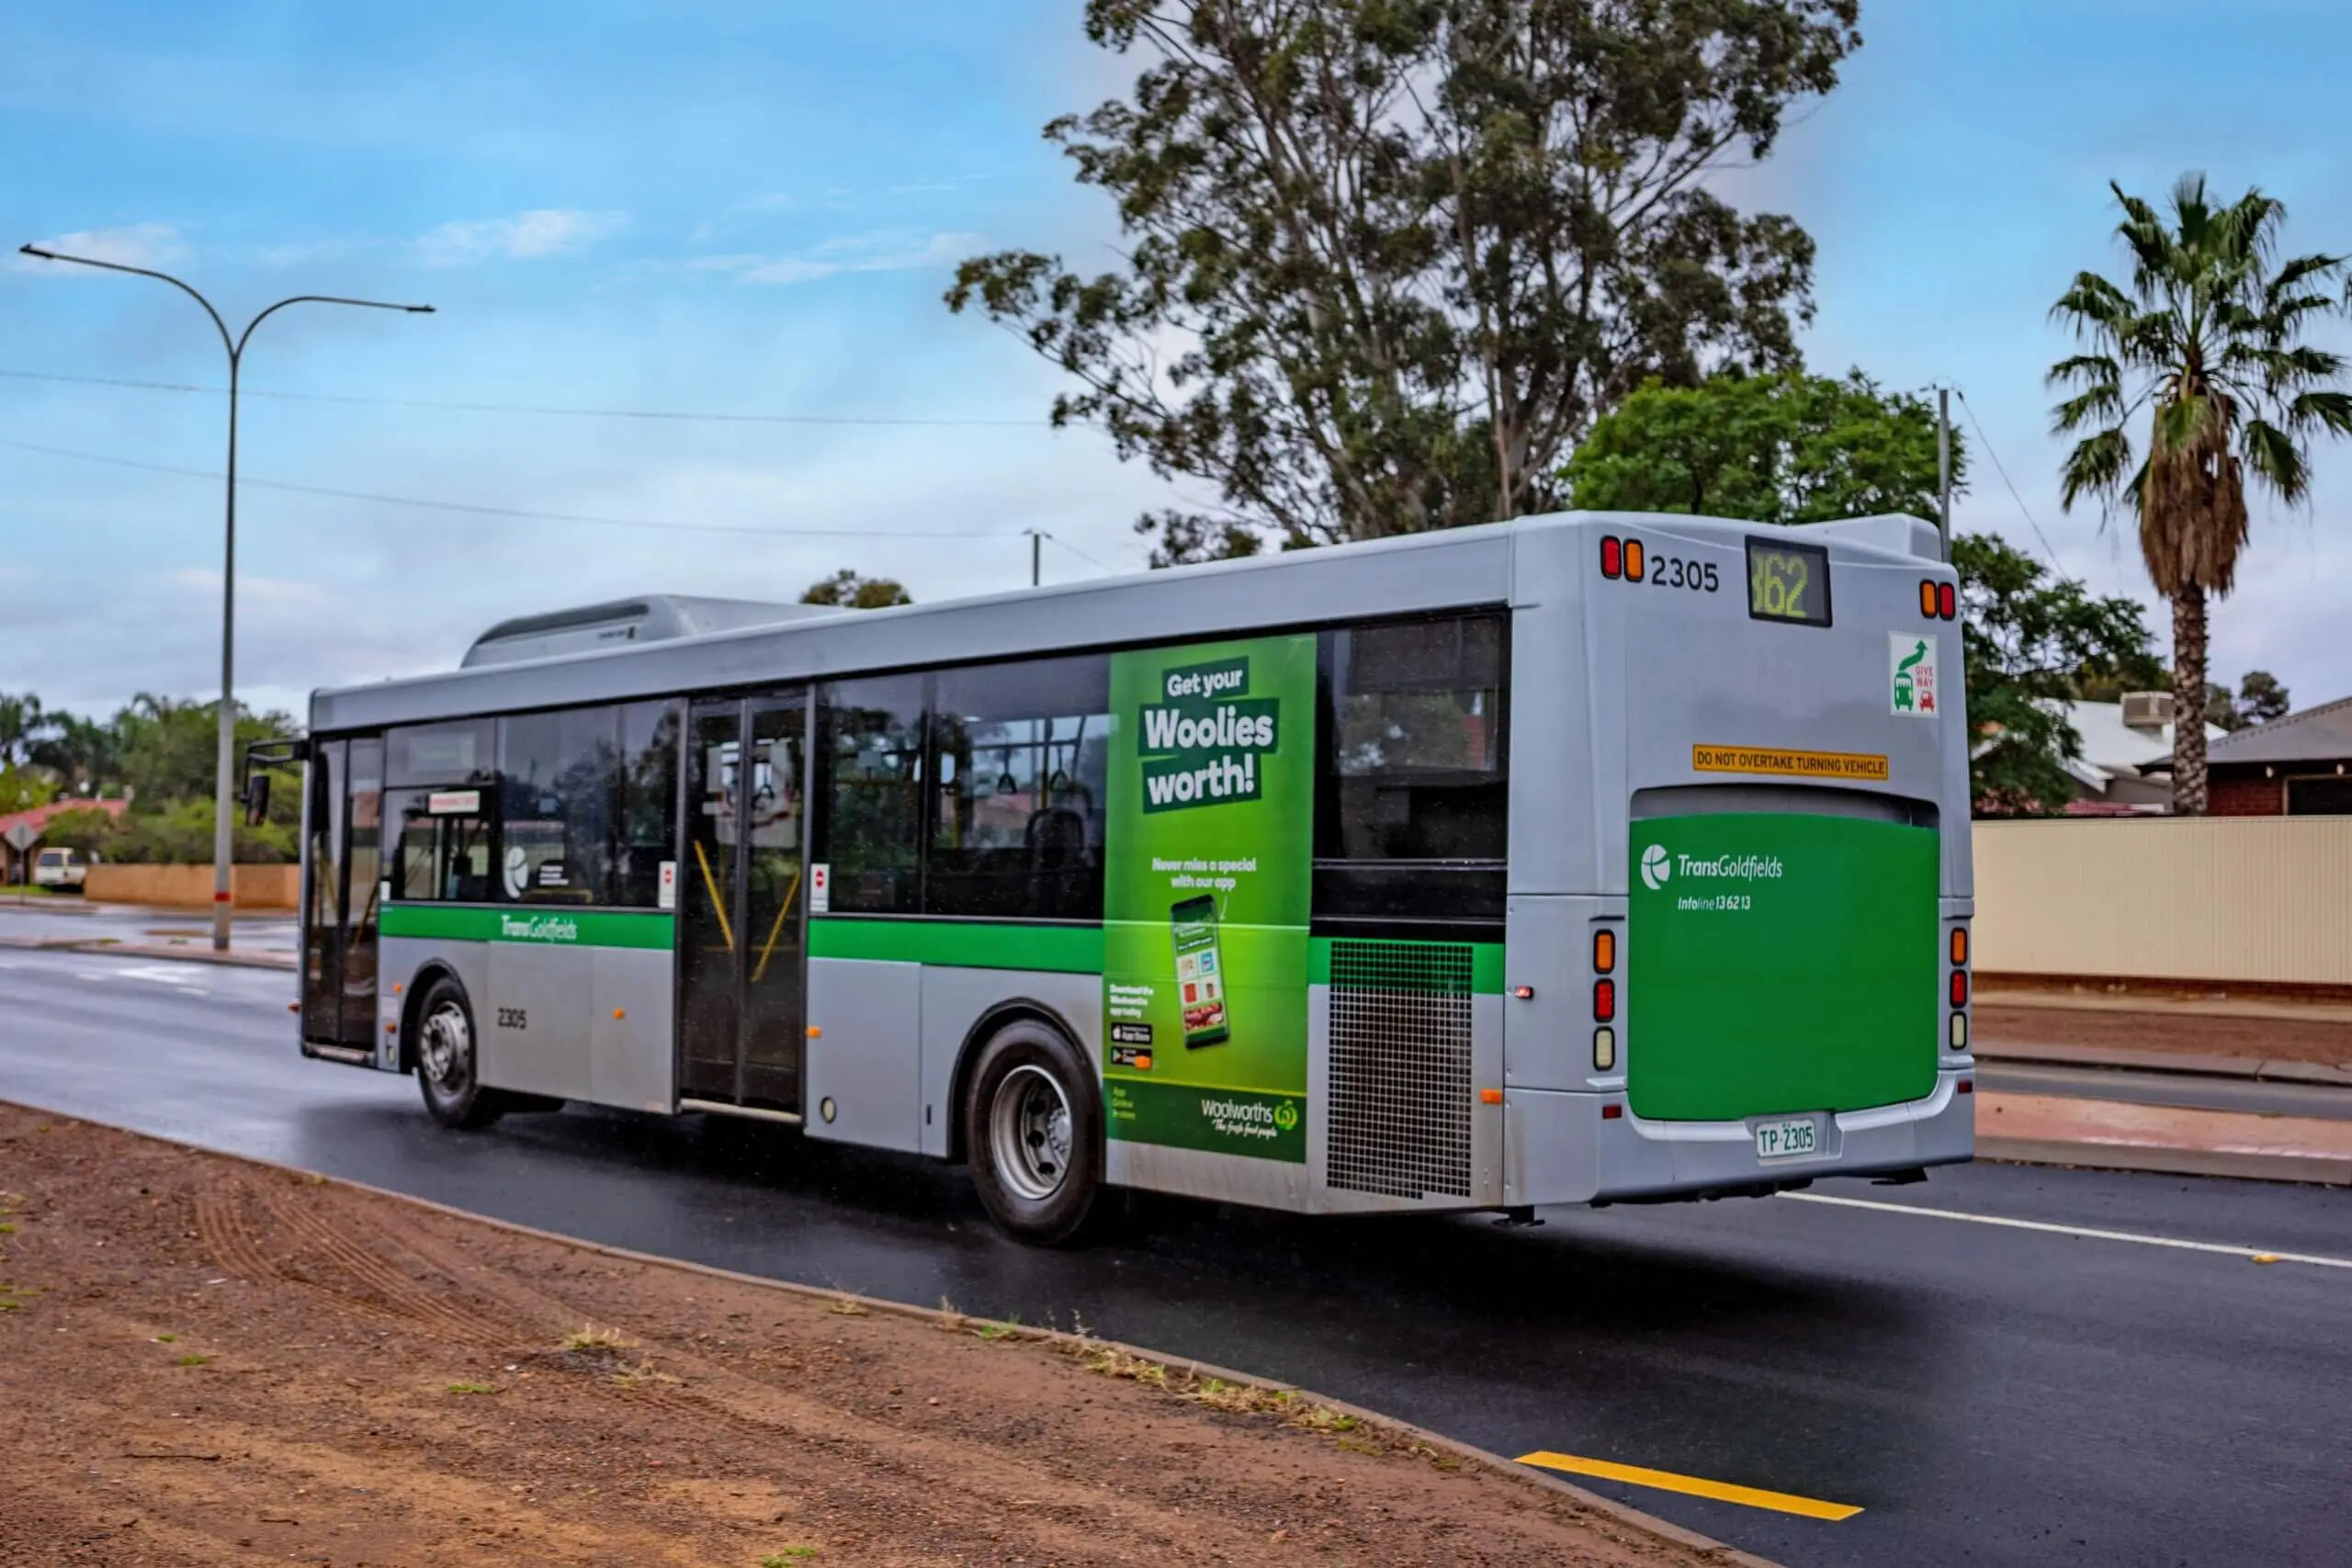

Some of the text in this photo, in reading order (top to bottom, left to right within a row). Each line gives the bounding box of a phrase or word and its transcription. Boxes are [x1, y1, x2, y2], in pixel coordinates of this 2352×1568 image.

[1650, 556, 1719, 592] 2305
[1916, 665, 1933, 676] GIVE
[1916, 677, 1933, 687] WAY
[1167, 669, 1243, 698] Get your
[1145, 705, 1273, 750] Woolies
[1697, 750, 1885, 774] DO NOT OVERTAKE TURNING VEHICLE
[1148, 752, 1255, 806] worth!
[1152, 856, 1257, 874] Never miss a special
[1678, 854, 1782, 882] TransGoldfields
[1170, 874, 1236, 892] with our app
[1678, 897, 1714, 910] Infoline
[501, 915, 577, 944] TransGoldfields
[498, 1008, 527, 1030] 2305
[1202, 1099, 1272, 1123] Woolworths
[1212, 1118, 1278, 1140] The fresh food people
